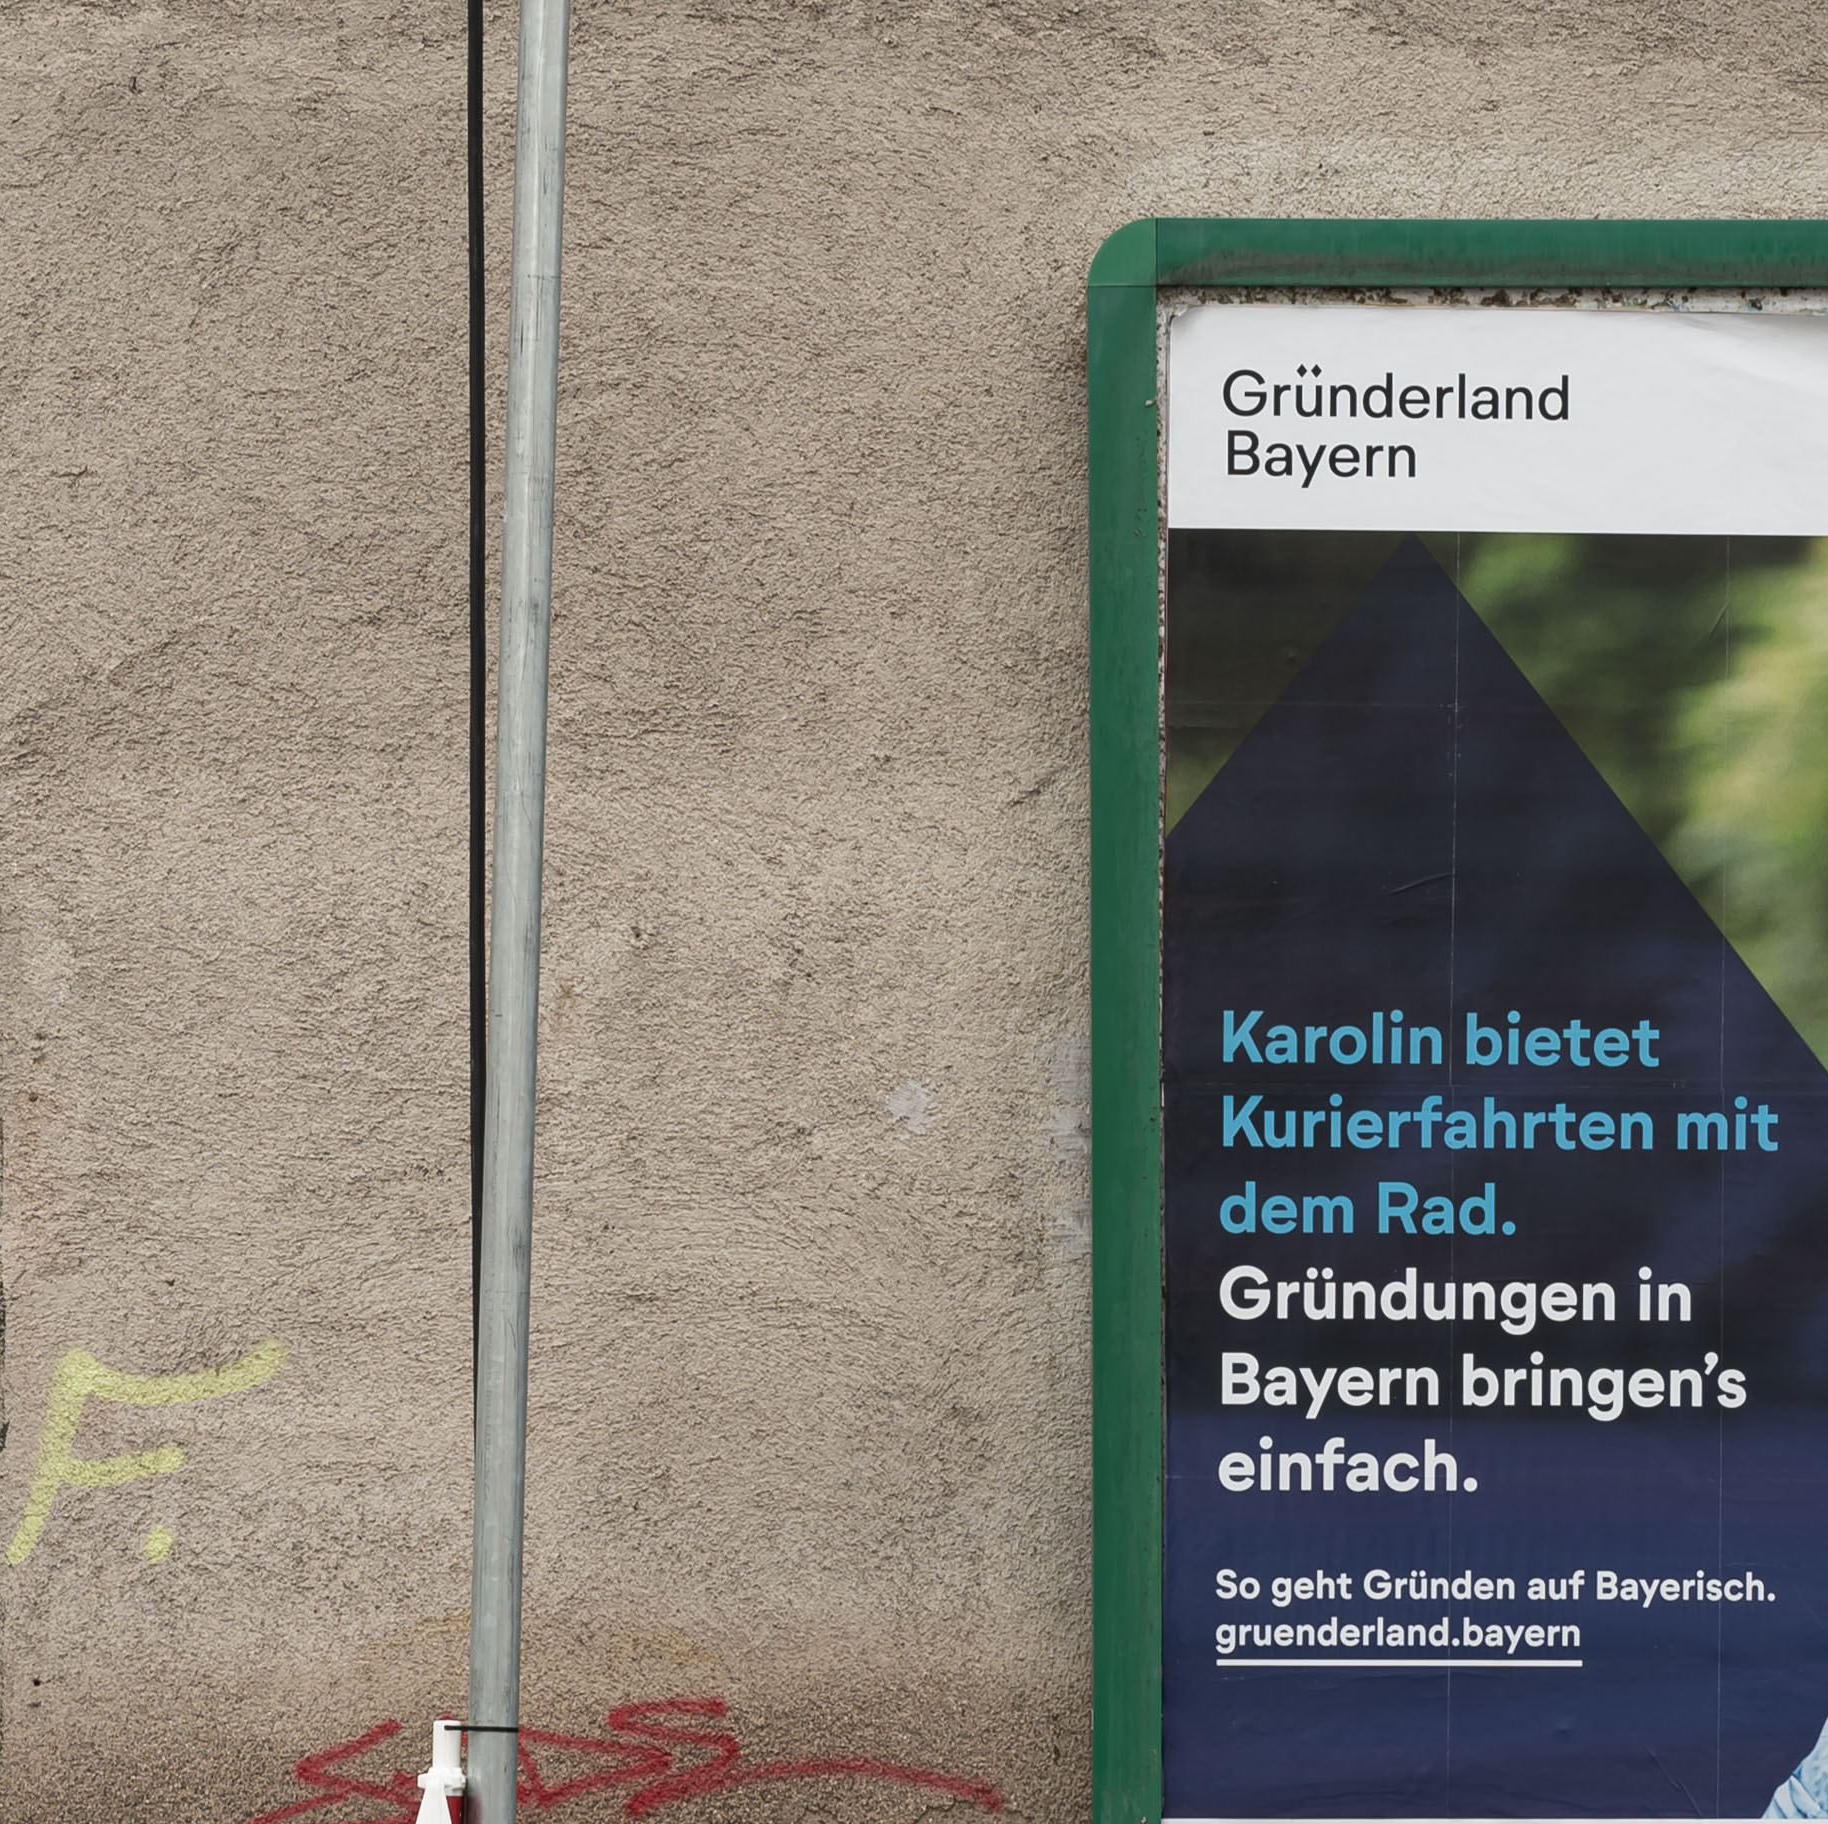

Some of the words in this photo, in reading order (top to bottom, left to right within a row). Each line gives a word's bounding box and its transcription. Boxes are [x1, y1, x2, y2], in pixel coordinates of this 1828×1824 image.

[1222, 363, 1571, 421] Gründerland
[1226, 429, 1417, 489] Bayern
[1222, 1009, 1443, 1065] Karolin
[1465, 1010, 1660, 1067] bietet
[1222, 1093, 1654, 1150] Kurierfahrten
[1676, 1096, 1779, 1152] mit
[1219, 1181, 1354, 1235] dem
[1378, 1182, 1517, 1236] Rad.
[1219, 1264, 1616, 1336] Gründungen
[1638, 1266, 1692, 1322] in
[1221, 1352, 1440, 1420] Bayern
[1218, 1435, 1479, 1492] einfach.
[1215, 1569, 1261, 1600] So
[1271, 1570, 1352, 1608] geht
[1363, 1569, 1517, 1601] Gründen
[1527, 1570, 1586, 1601] auf
[1596, 1570, 1777, 1608] Bayerisch.
[1215, 1616, 1582, 1655] gruenderland.bayern
